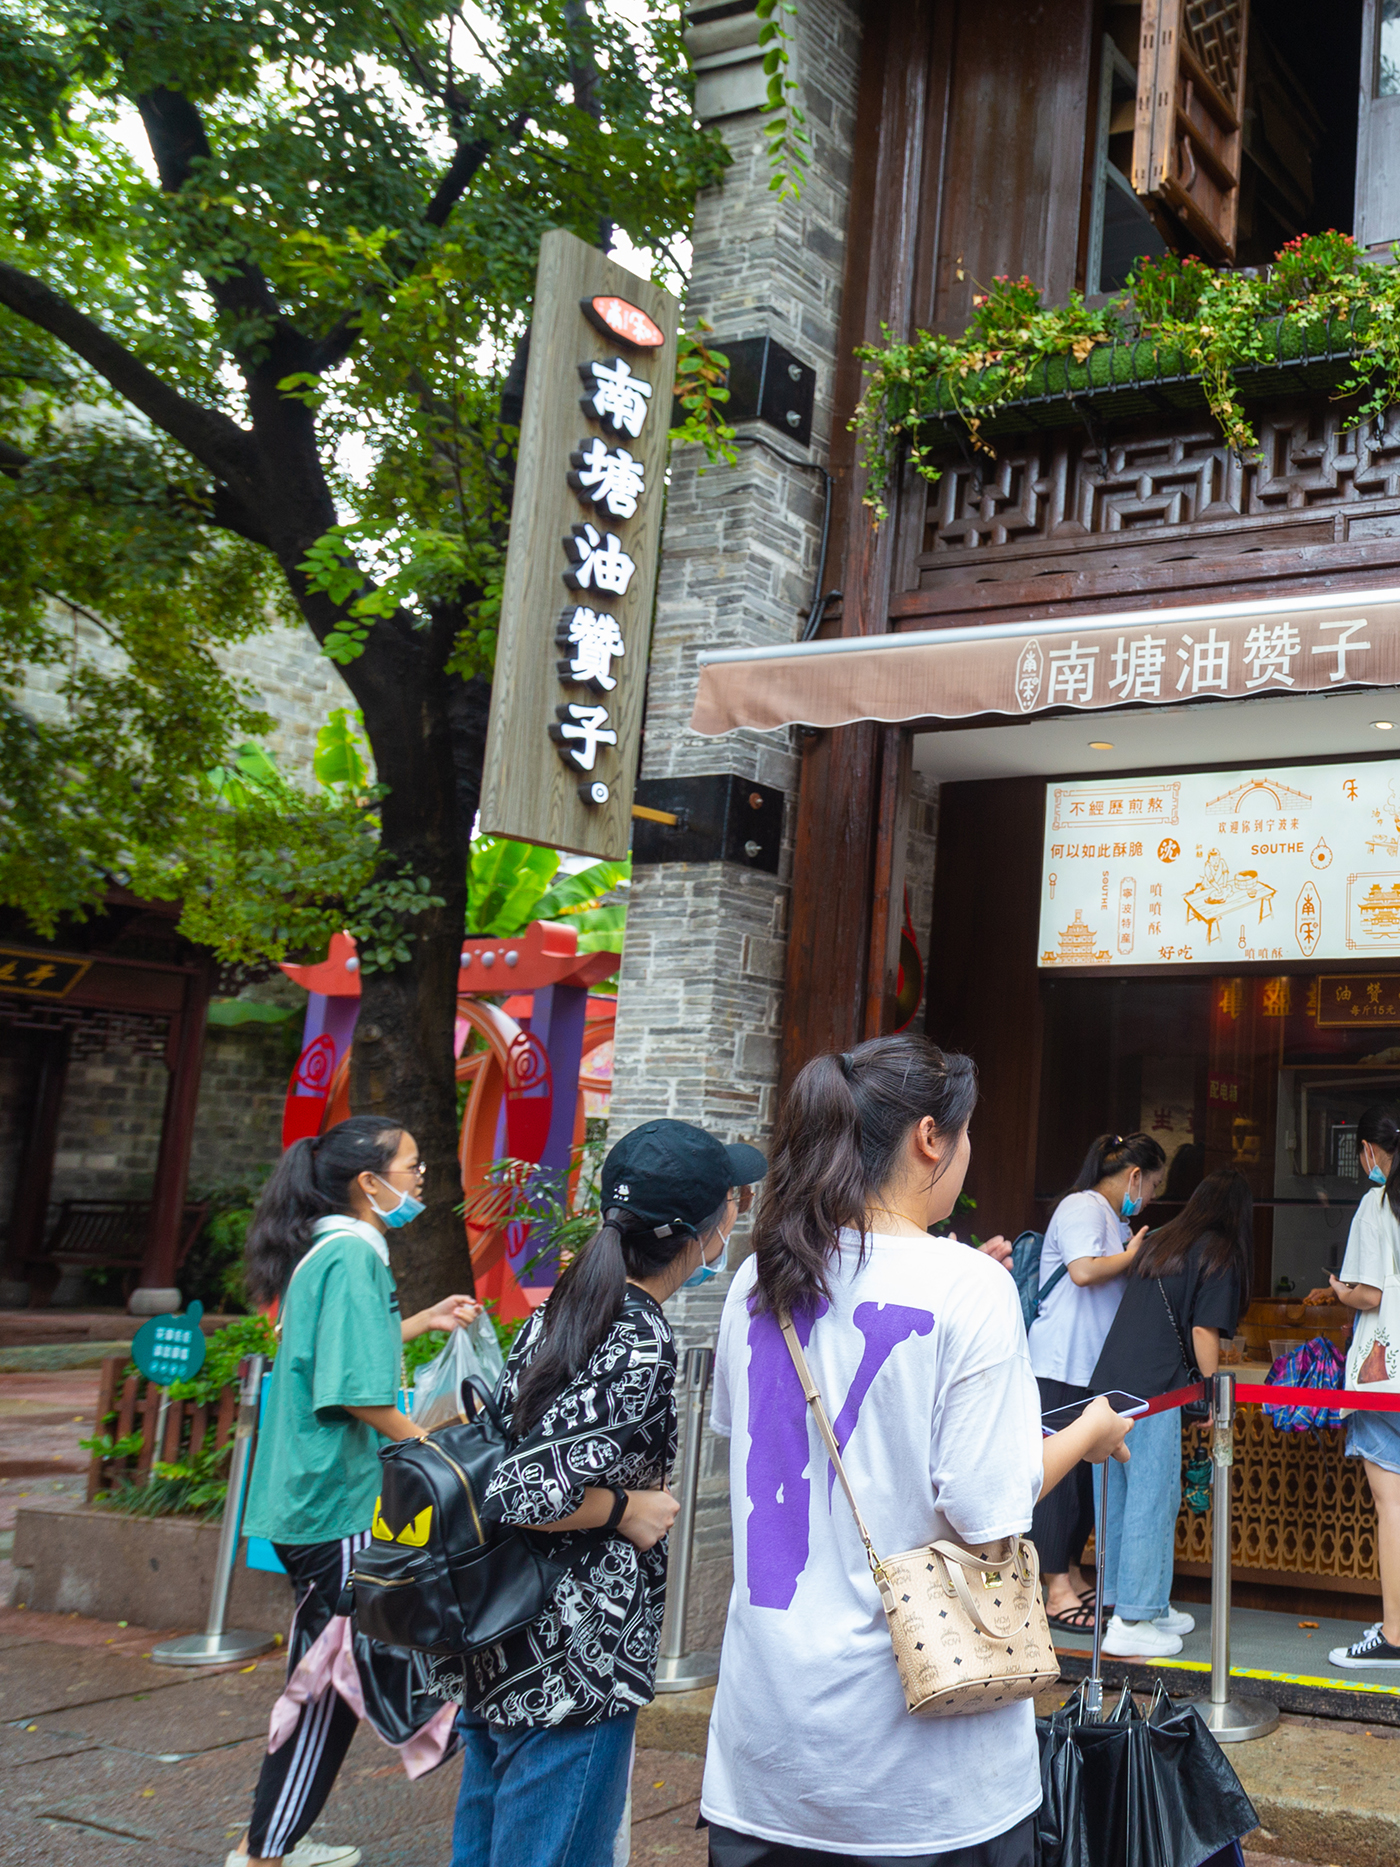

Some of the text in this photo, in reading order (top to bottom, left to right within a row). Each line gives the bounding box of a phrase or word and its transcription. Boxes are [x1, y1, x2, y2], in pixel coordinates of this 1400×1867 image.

[1046, 618, 1371, 704] 南塘油赞子
[1069, 797, 1163, 816] 不經歷煎熬
[1218, 818, 1299, 834] 欢迎你到宁波来
[1050, 841, 1144, 859] 何以如此酥脆
[1251, 842, 1304, 855] SOUTHE
[1101, 870, 1110, 911] SOUTHE
[1158, 944, 1193, 960] 好吃
[1350, 1003, 1397, 1017] 每斤15元
